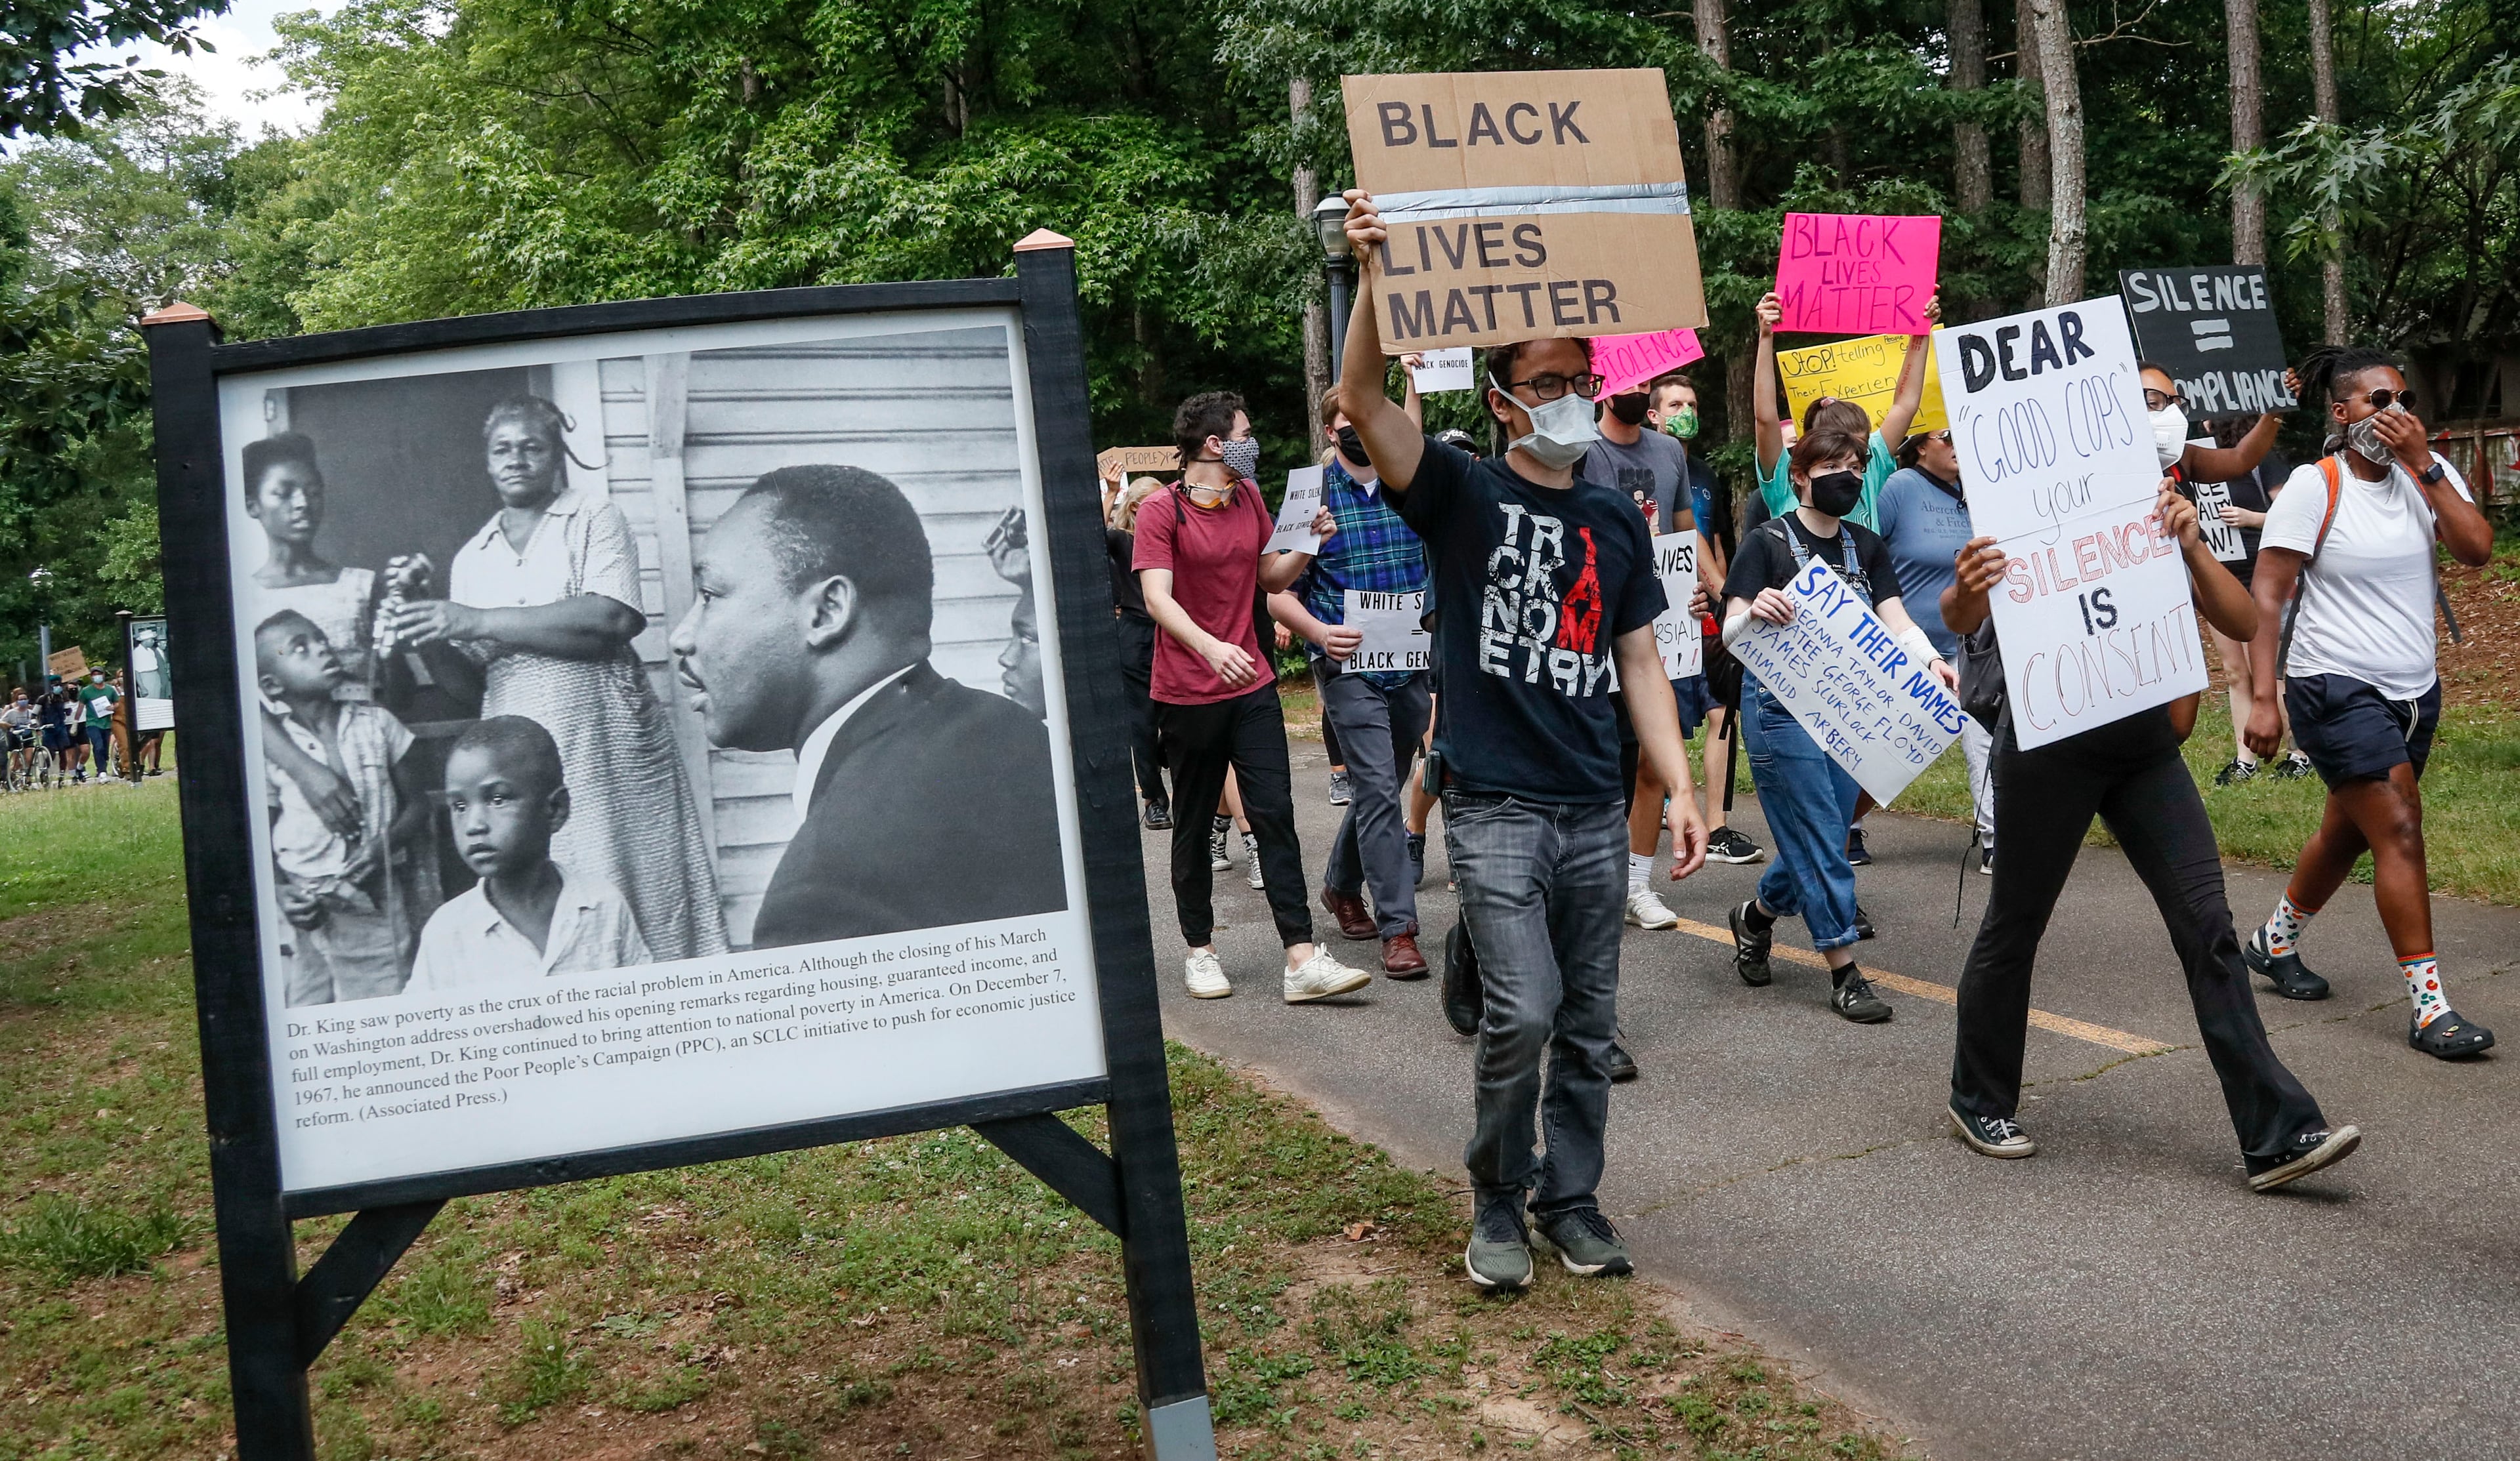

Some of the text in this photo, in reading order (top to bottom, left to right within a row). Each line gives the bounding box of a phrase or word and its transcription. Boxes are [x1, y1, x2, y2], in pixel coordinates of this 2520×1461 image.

[1377, 100, 1591, 148] BLACK
[1379, 222, 1547, 277] LIVES
[1791, 215, 1905, 265] BLACK
[1822, 260, 1881, 285] LIVES
[2128, 272, 2267, 313] SILENCE
[1387, 279, 1622, 340] MATTER
[1782, 281, 1916, 330] MATTER
[1439, 359, 1468, 369] GENOCIDE
[1837, 343, 1885, 365] telling
[1958, 312, 2095, 393] DEAR
[1789, 386, 1817, 399] Their
[2173, 368, 2298, 413] OMPLIANCE
[1935, 518, 1944, 527] &
[2032, 472, 2095, 546] your
[1662, 545, 1693, 575] IVES
[2005, 512, 2174, 604] SILENCE
[1360, 592, 1403, 610] WHITE
[2078, 587, 2118, 636] IS
[1350, 653, 1395, 670] BLACK
[1752, 618, 1815, 680] JAMES
[1796, 566, 1969, 735] SAY THEIR NAMES
[2022, 602, 2194, 731] CONSENT
[1737, 640, 1862, 772] AHMAUD ARBERY
[1822, 665, 1876, 716] GEORGE
[1875, 716, 1925, 765] FLOYD
[1849, 657, 1894, 710] TAYLOR
[1899, 712, 1943, 756] DAVID
[287, 928, 1046, 1037] Dr. King saw poverty as the crux of the racial problem in America. Although the closing of his March
[289, 948, 1057, 1060] on Washington address overshadowed his opening remarks regarding housing, guaranteed income, and
[292, 969, 1066, 1082] full employment, Dr. King continued to bring attention to national poverty in America. On December 7,
[296, 991, 1075, 1105] 1967, he announced the Poor People's Campaign (PPC), an SCLC initiative to push for economic justice
[296, 1089, 507, 1128] reform. (Associated Press.)
